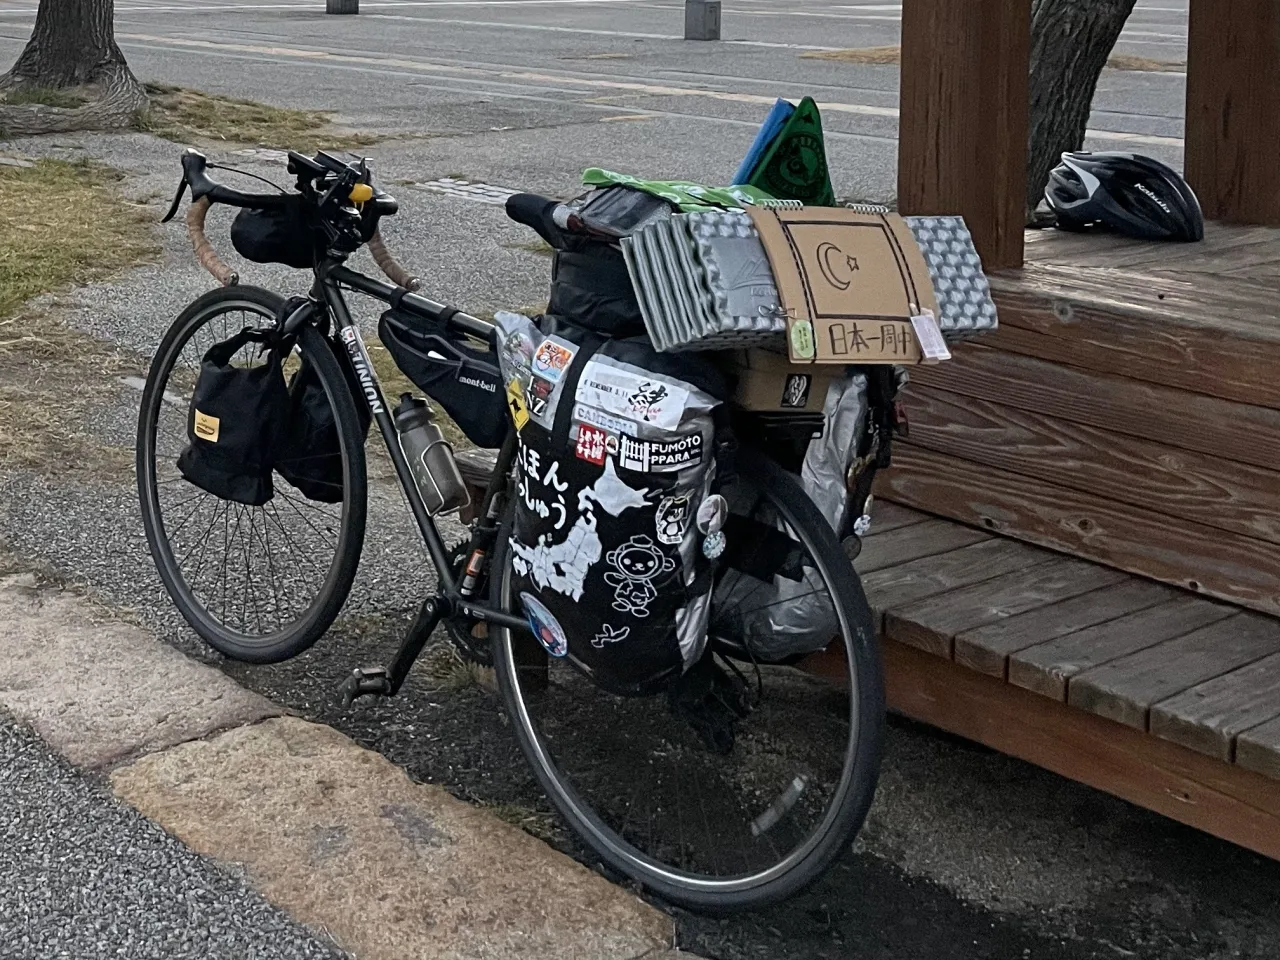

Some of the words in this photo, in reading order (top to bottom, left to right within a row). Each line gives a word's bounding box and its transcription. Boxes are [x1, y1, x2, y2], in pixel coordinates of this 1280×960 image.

[829, 322, 912, 355] 日本一周中
[459, 376, 497, 393] mont-bell
[526, 390, 546, 416] NZ
[651, 435, 701, 453] FUMOTO
[651, 451, 690, 464] PPARA
